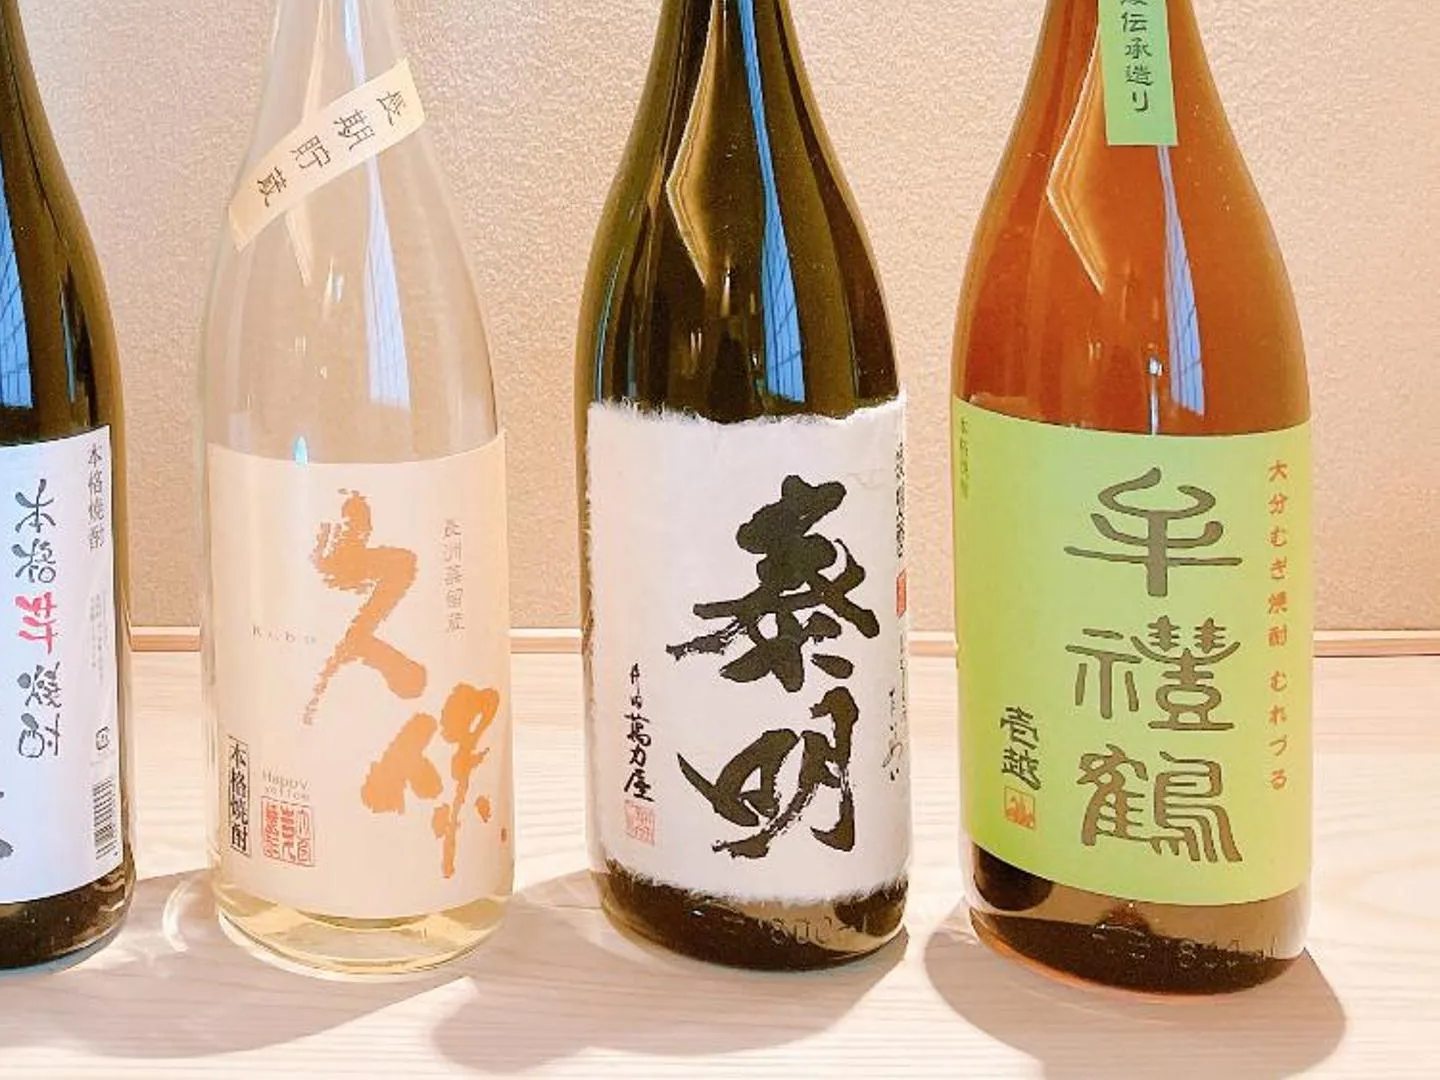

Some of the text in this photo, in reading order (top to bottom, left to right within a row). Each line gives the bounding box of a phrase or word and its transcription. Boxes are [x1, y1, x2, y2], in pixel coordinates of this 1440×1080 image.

[256, 89, 407, 208] 長期貯蔵
[664, 474, 881, 860] 泰明
[1266, 459, 1289, 791] 大分むぎ焼酎 むれづる
[229, 742, 249, 852] 本格焼酎
